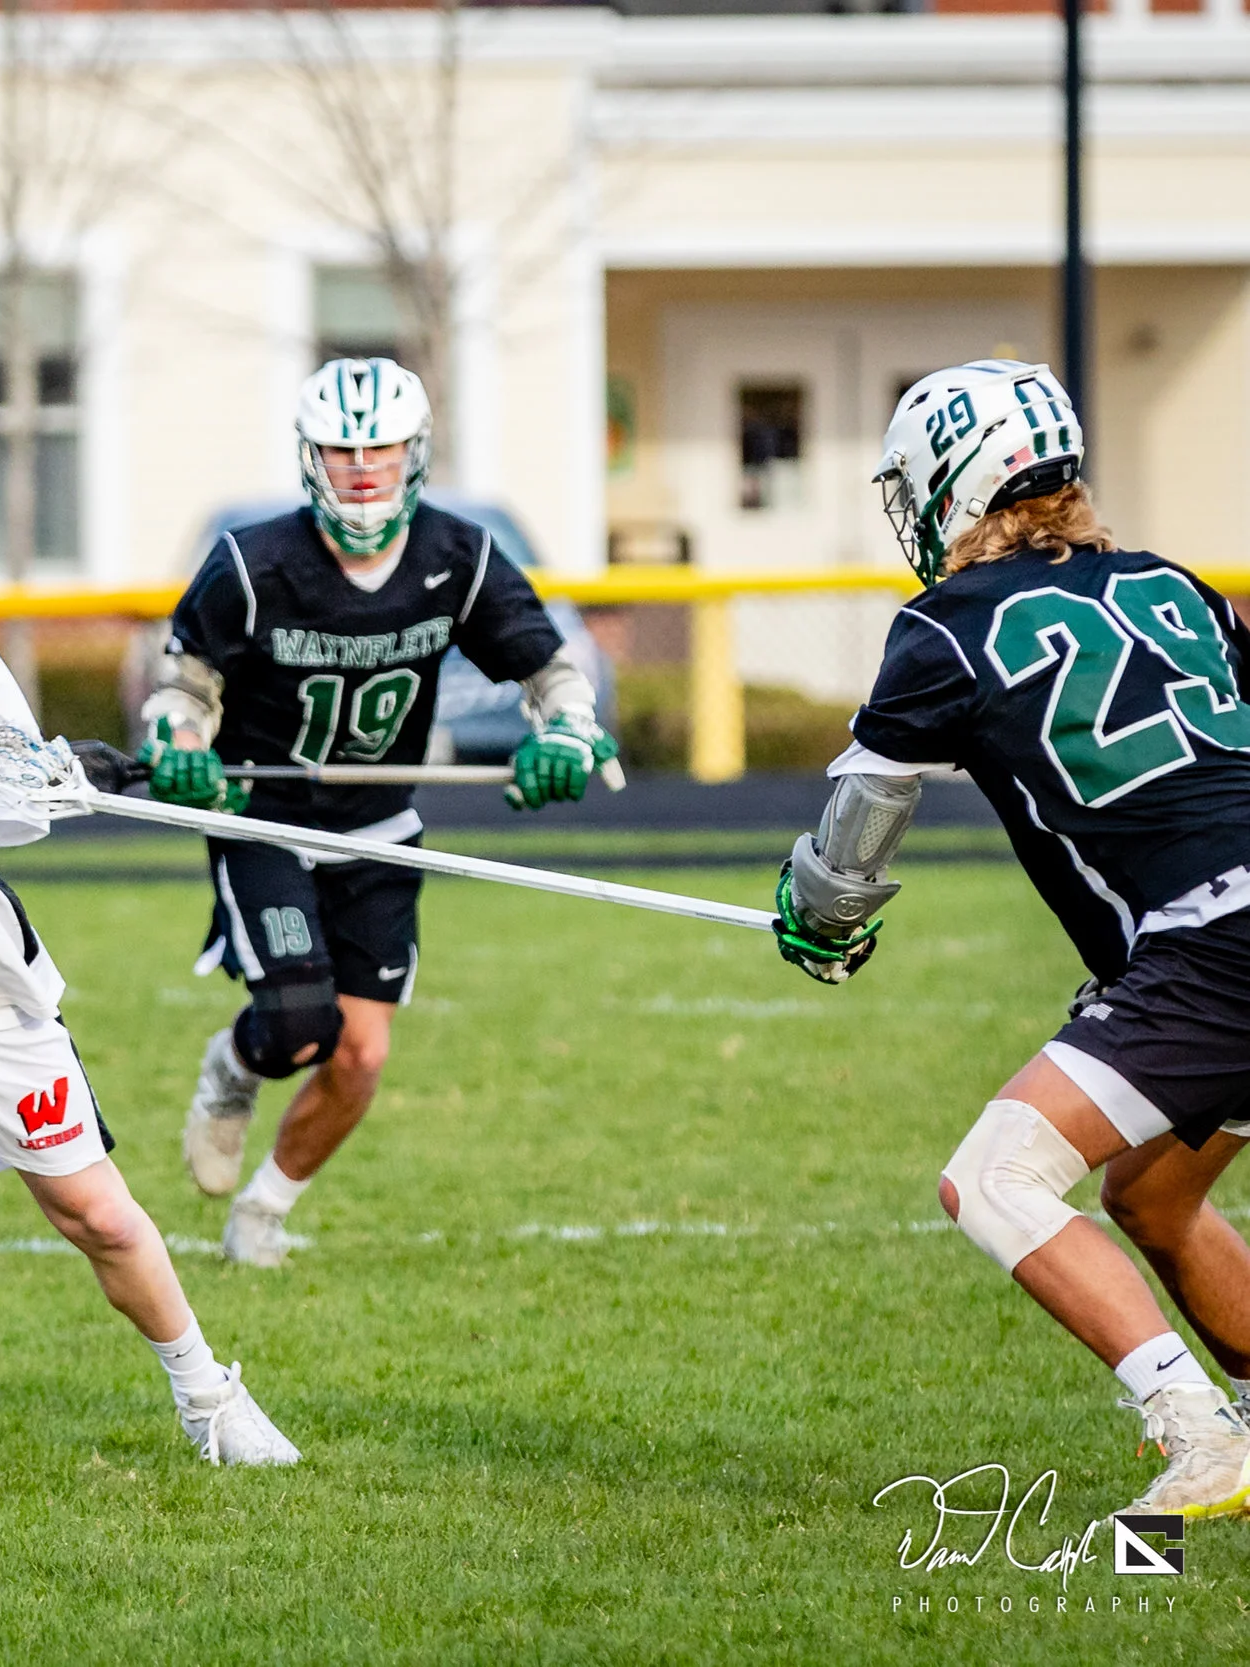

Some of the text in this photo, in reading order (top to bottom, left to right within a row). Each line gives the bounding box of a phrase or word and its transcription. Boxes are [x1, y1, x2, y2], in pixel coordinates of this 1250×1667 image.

[926, 391, 977, 460] 29
[271, 616, 453, 669] WAYNFLETE
[290, 668, 421, 767] 19
[984, 567, 1250, 808] 29
[260, 906, 313, 958] 19
[17, 1076, 68, 1136] W
